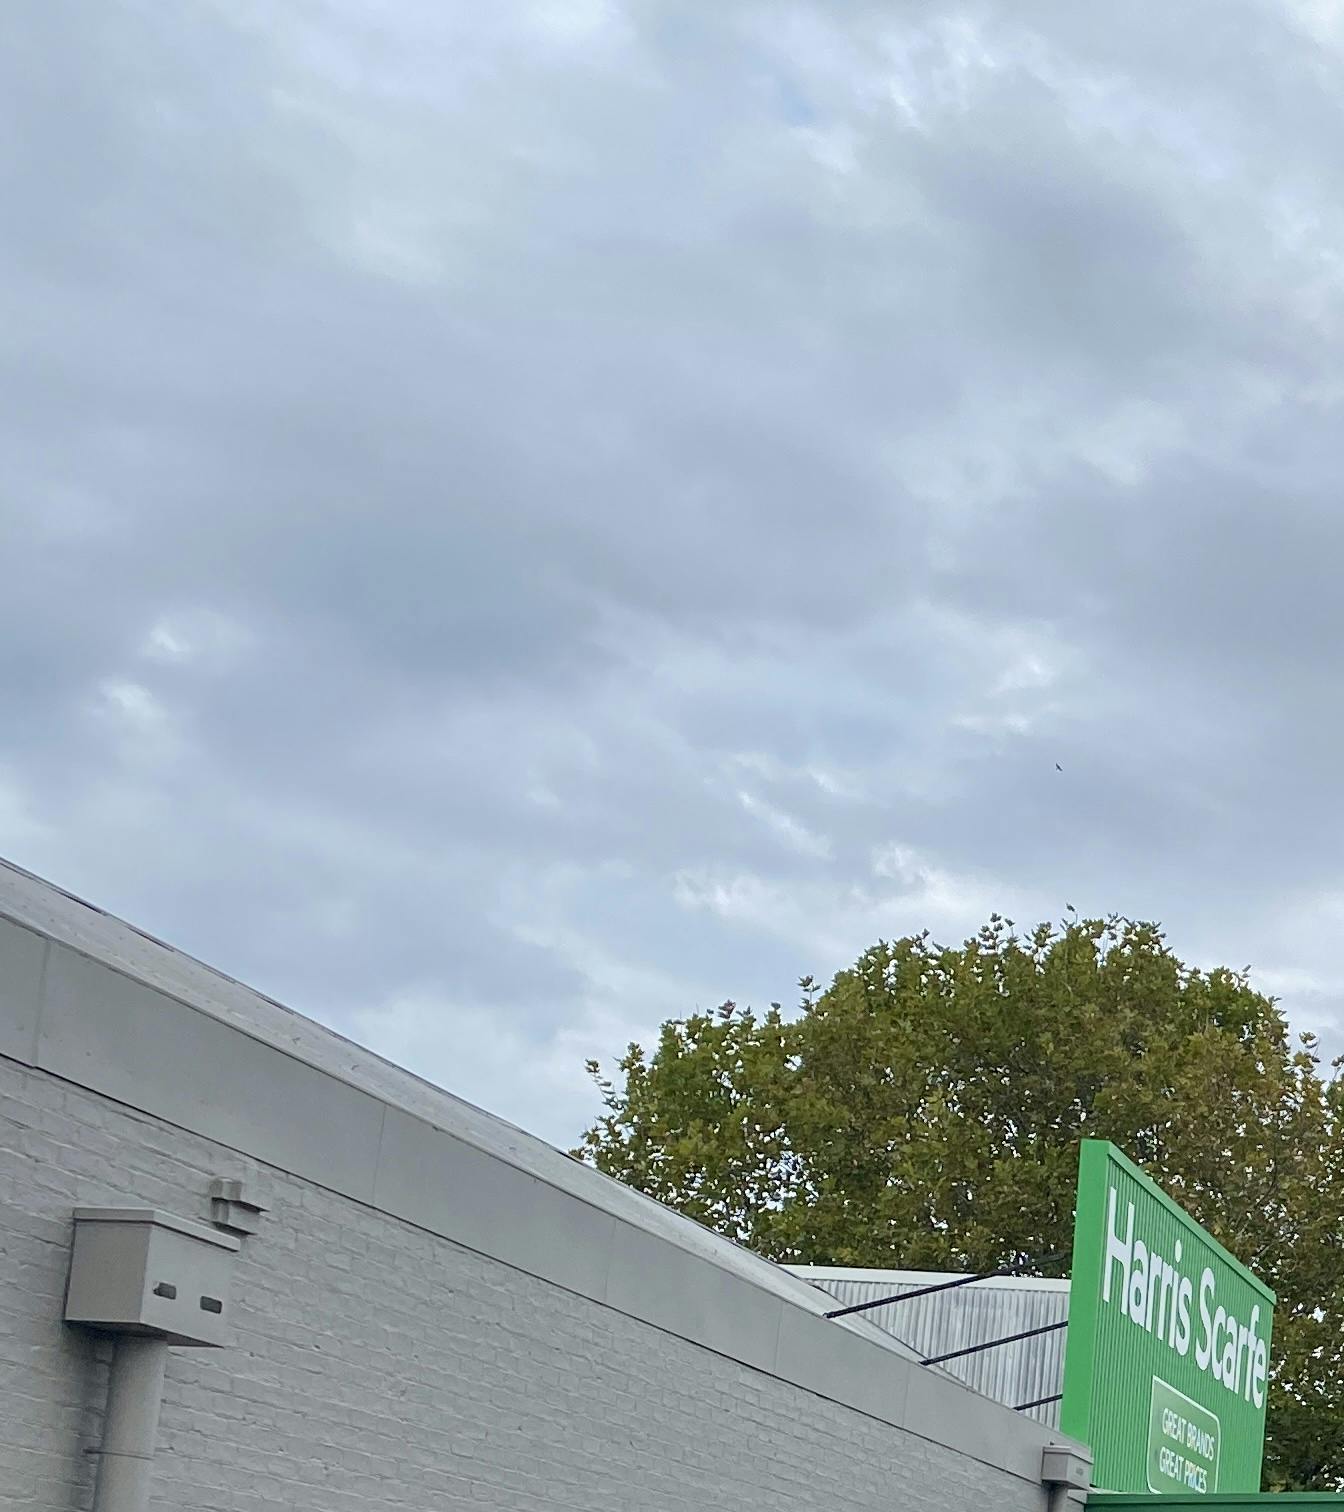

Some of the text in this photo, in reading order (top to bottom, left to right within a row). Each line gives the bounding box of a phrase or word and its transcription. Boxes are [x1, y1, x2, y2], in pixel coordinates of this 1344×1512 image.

[1103, 1186, 1267, 1410] Harris Scarfe
[1162, 1407, 1215, 1462] GREAT BRANDS
[1159, 1446, 1208, 1494] GREAT PRICES
